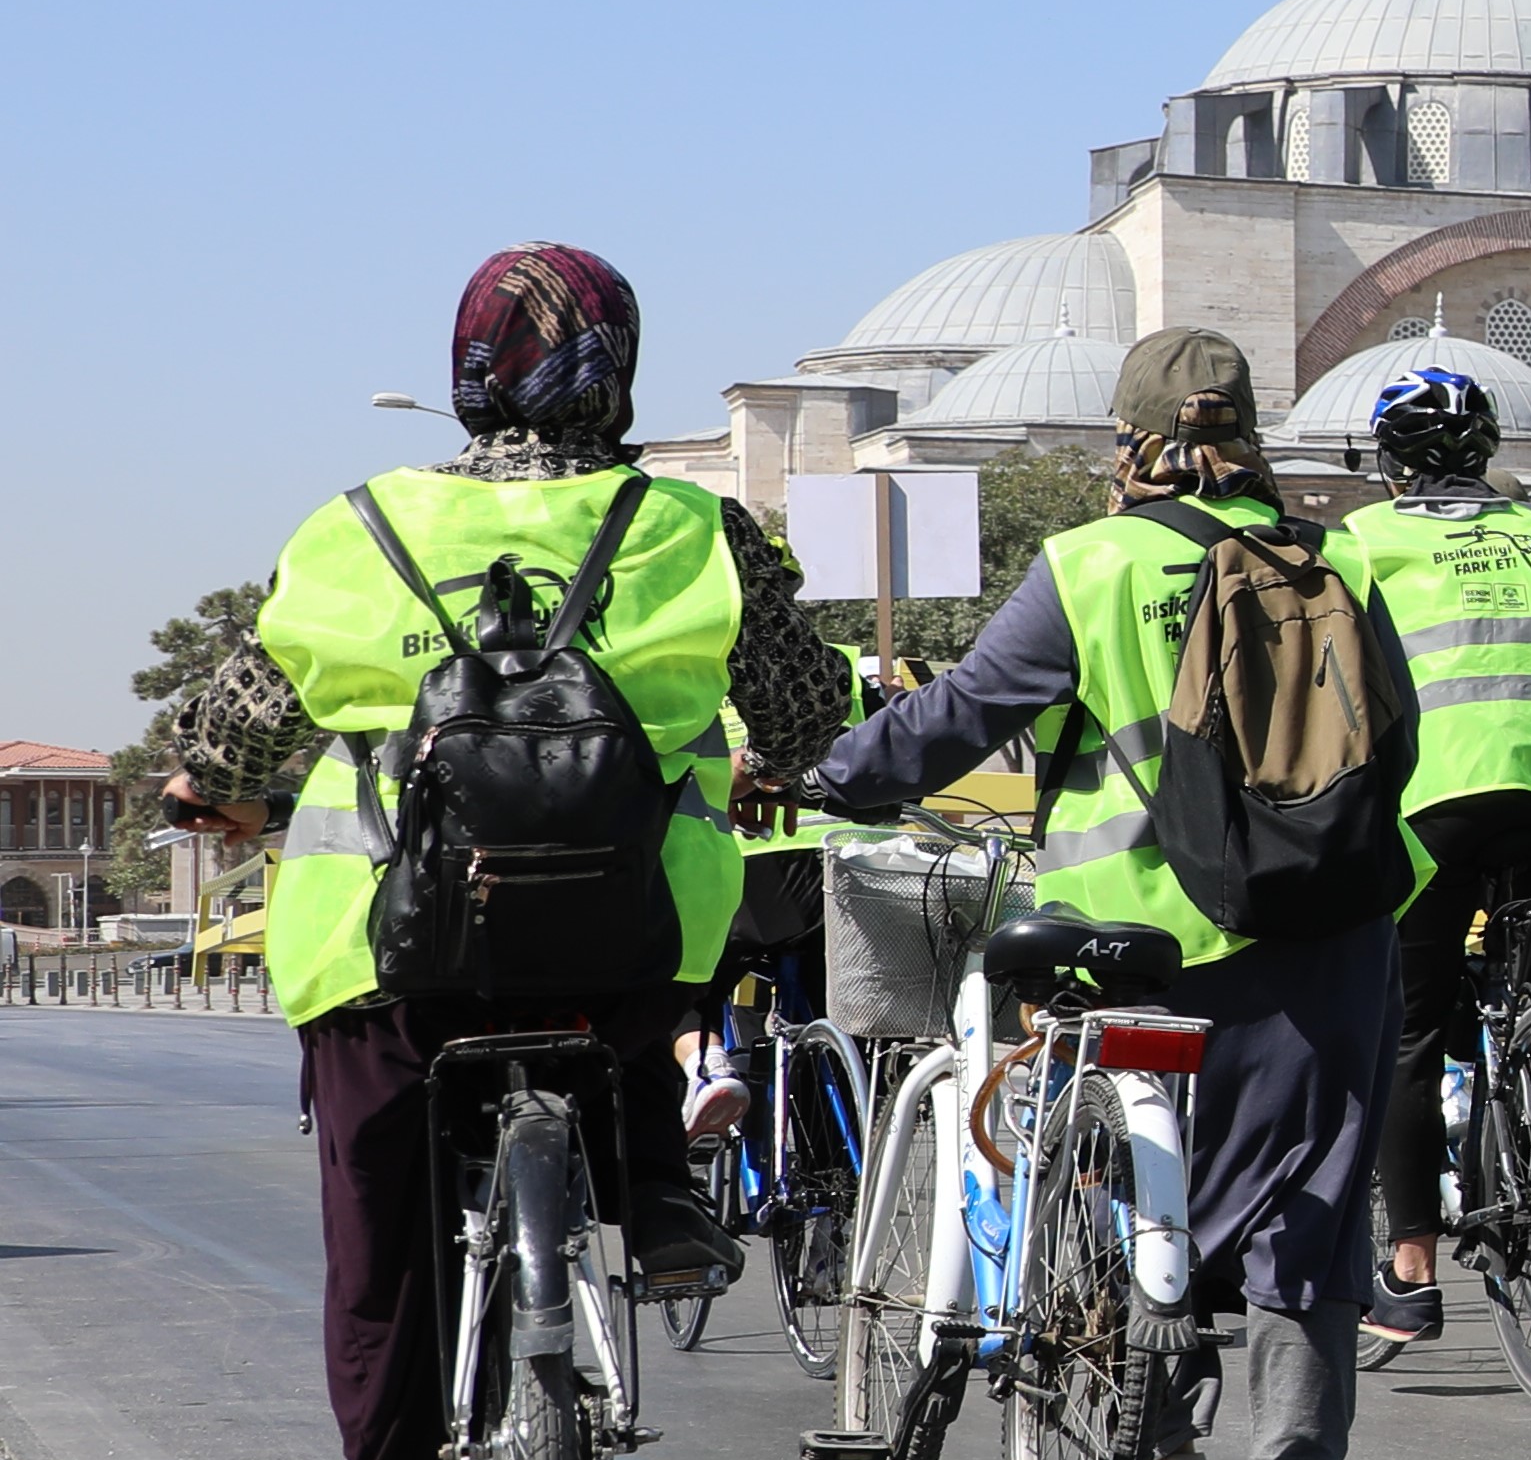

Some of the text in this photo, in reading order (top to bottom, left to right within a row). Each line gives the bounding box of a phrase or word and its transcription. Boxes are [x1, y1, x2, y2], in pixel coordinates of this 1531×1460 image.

[1433, 544, 1512, 565] Bisikletliyi
[1454, 557, 1518, 576] FARK ET!
